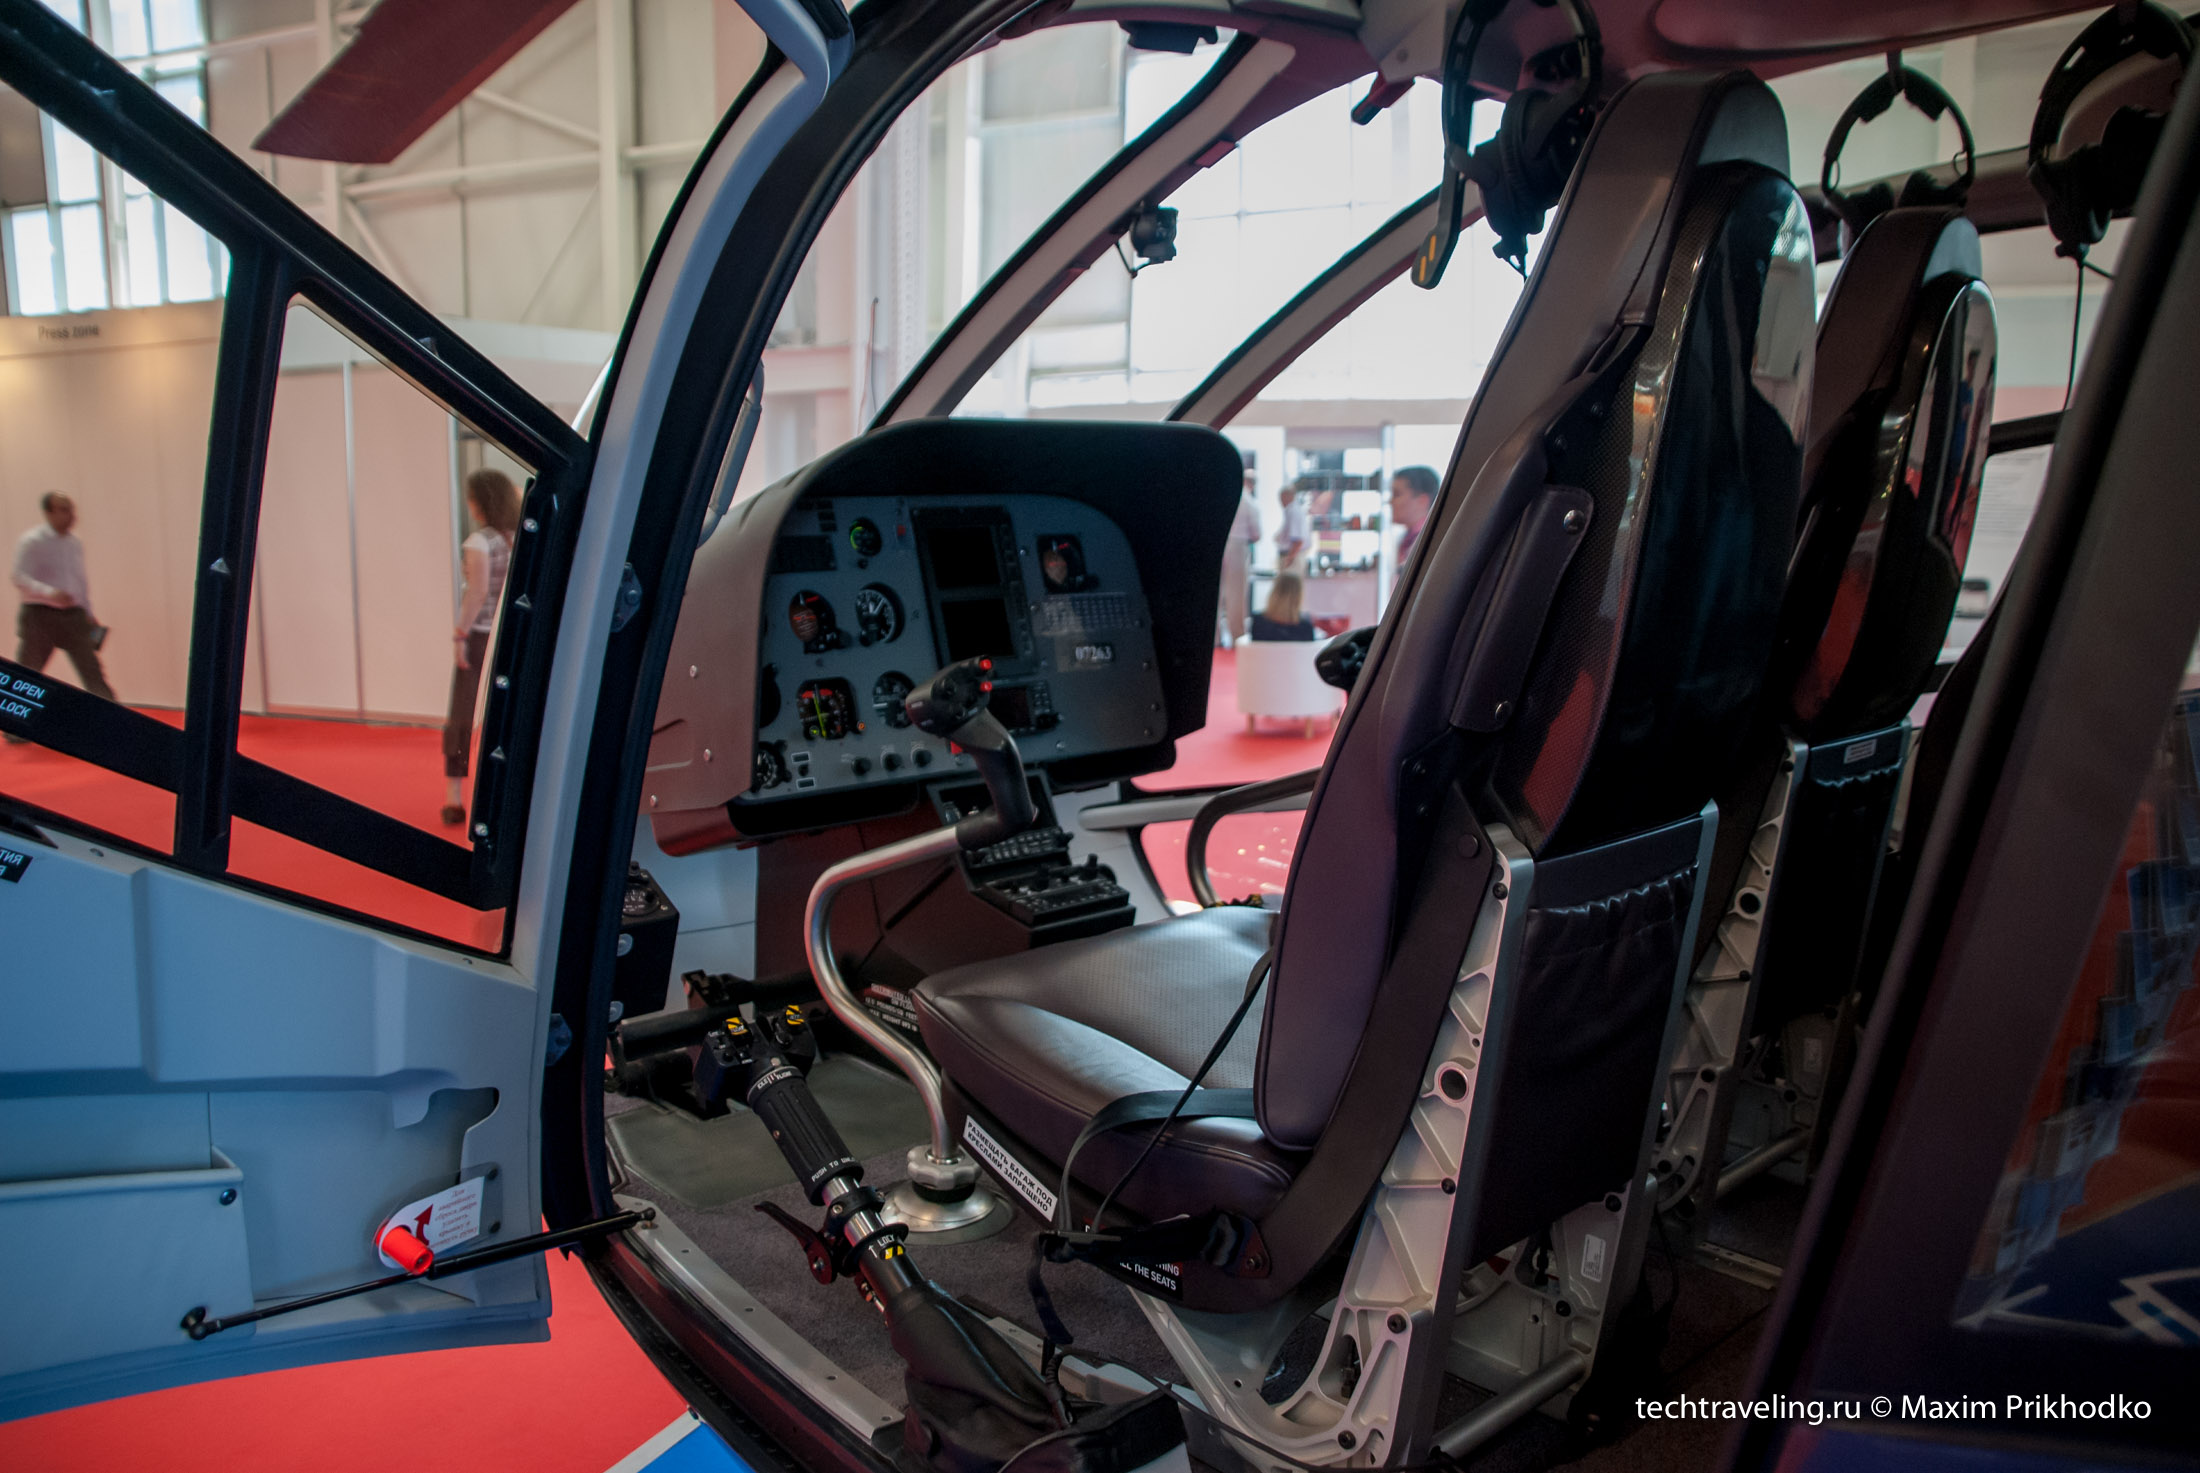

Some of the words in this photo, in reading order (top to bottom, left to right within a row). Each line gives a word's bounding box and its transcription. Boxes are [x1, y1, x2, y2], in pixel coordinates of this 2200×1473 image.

[38, 326, 70, 339] Press
[72, 325, 99, 337] zone
[12, 680, 45, 699] OPEN
[811, 1166, 827, 1182] PUSH
[829, 1160, 839, 1169] TO
[967, 1131, 1003, 1170] КРЕСЛАМИ
[1003, 1167, 1048, 1212] ЗАПРЕЩЕНО
[968, 1121, 1009, 1165] РАЗМЕЩАТЬ
[1009, 1162, 1035, 1189] БАГАЖ
[1036, 1186, 1053, 1207] ПОД
[1134, 1263, 1150, 1279] THE
[1150, 1270, 1177, 1291] SEATS
